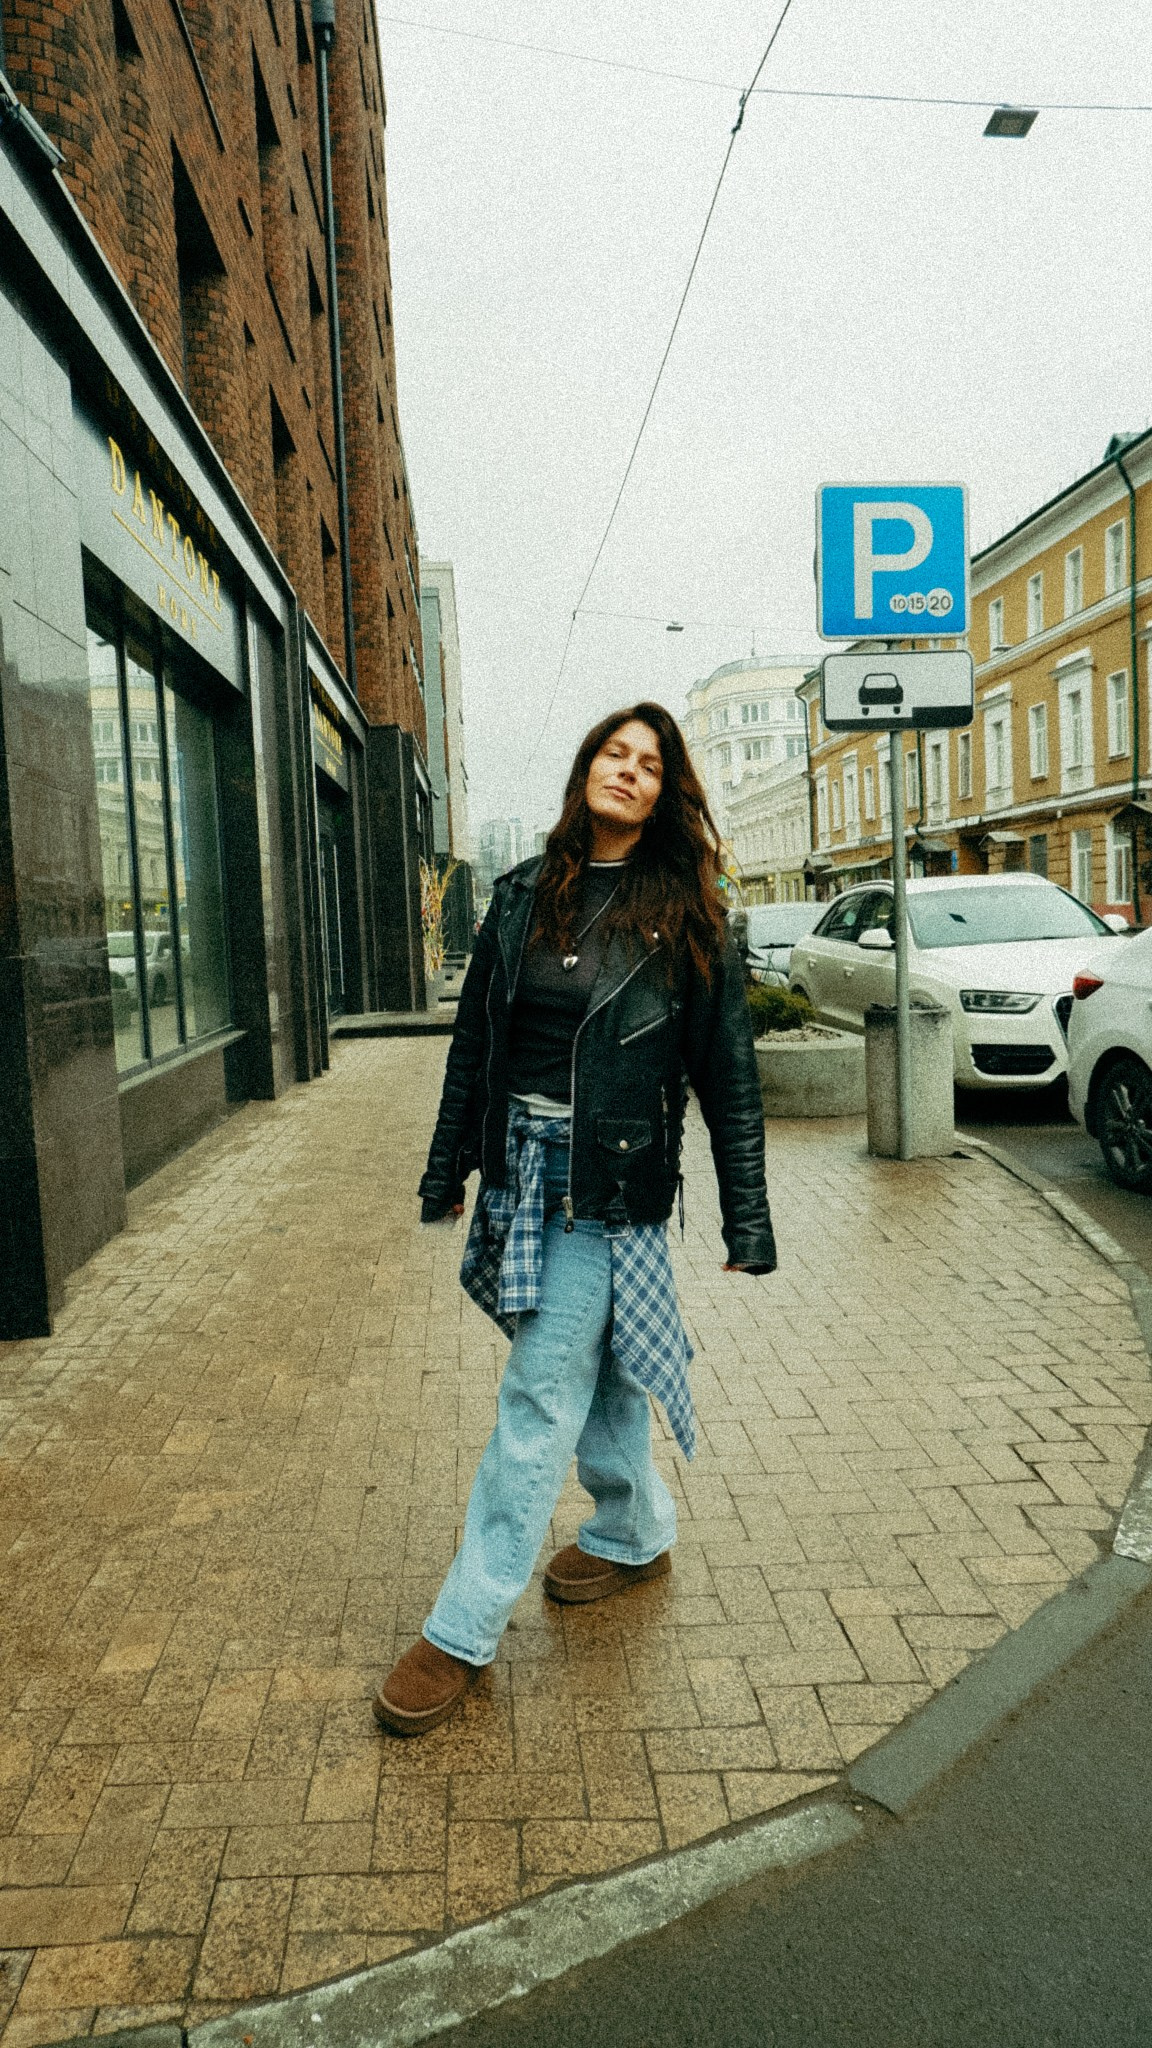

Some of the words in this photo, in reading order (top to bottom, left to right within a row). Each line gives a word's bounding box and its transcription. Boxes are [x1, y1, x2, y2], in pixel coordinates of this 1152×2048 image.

[108, 436, 222, 614] DANTONE
[854, 502, 934, 619] P
[893, 598, 906, 609] 10
[910, 597, 925, 610] 15
[929, 595, 951, 610] 20
